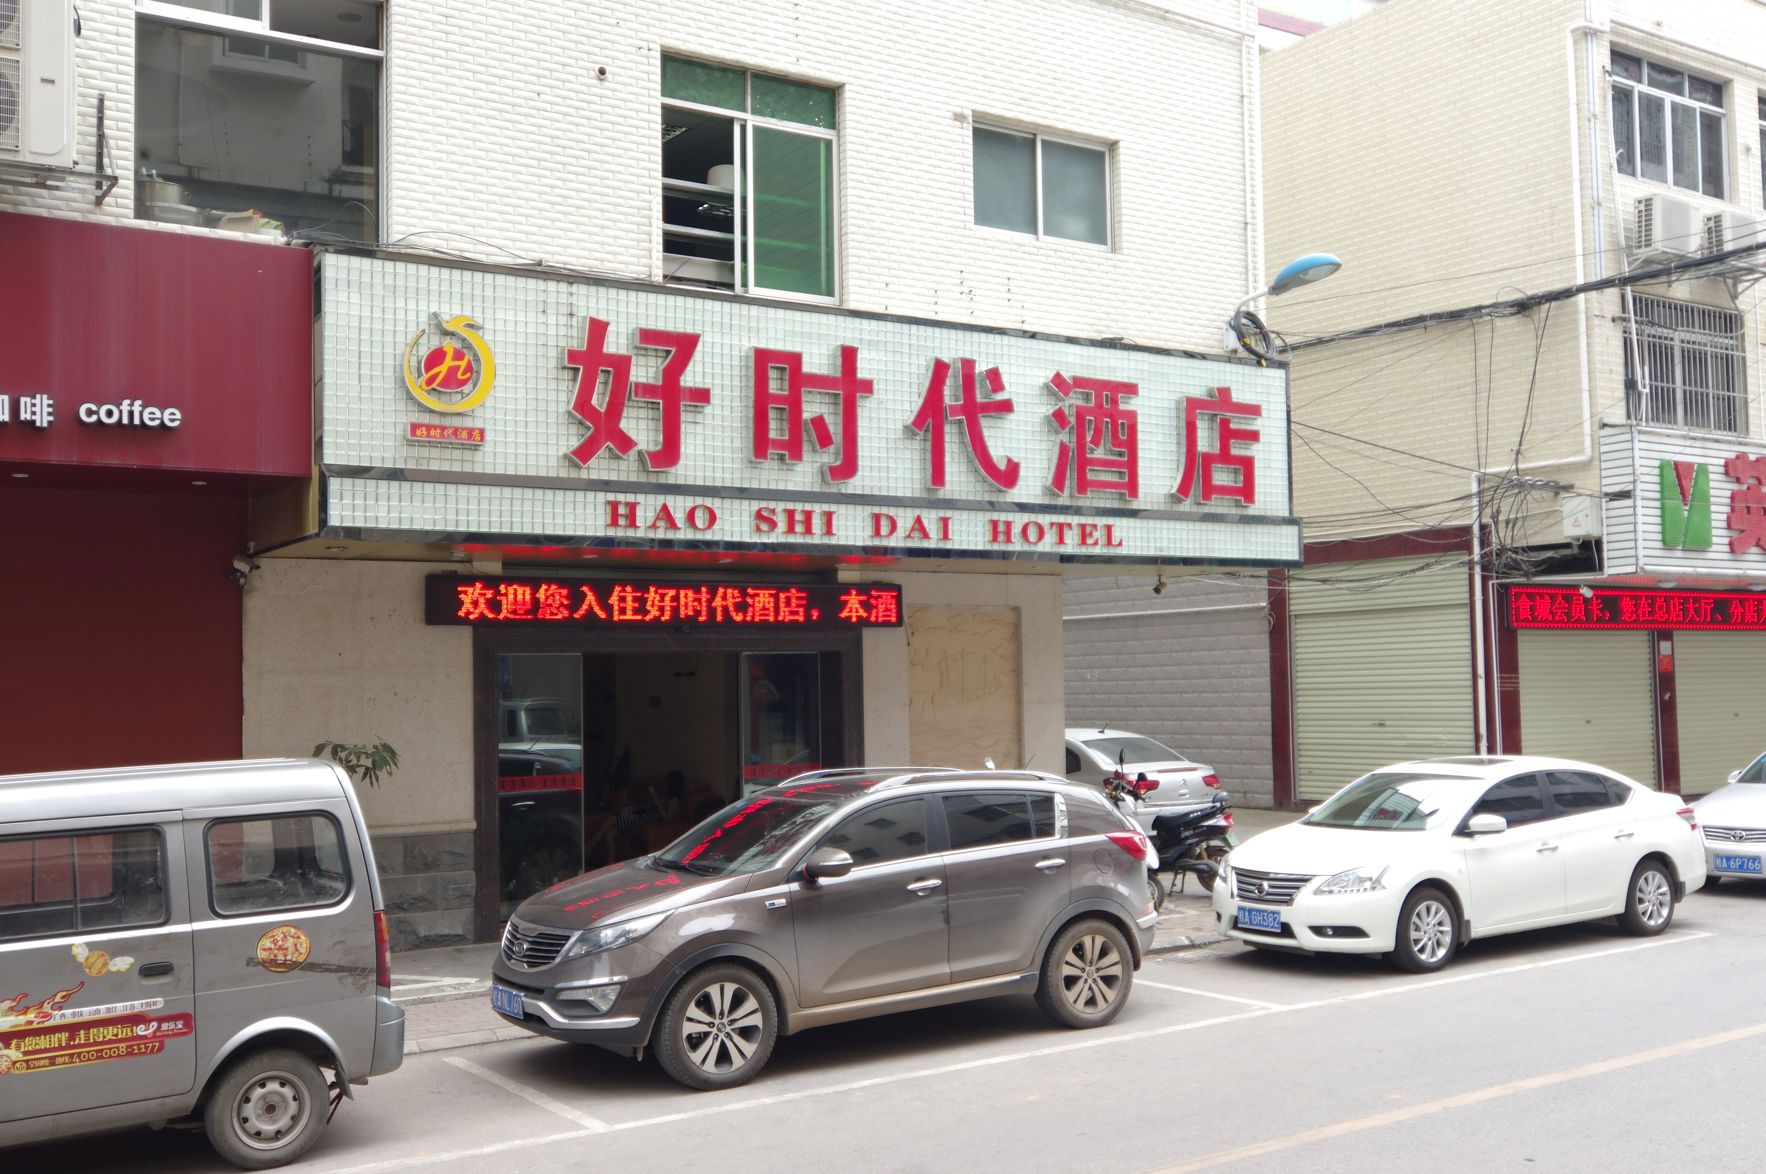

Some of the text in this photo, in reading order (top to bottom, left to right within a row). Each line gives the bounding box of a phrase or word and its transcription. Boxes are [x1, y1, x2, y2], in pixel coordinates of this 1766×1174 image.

[79, 399, 182, 427] coffee
[565, 316, 1263, 506] 好时代酒店
[414, 426, 482, 442] 好时代酒店
[605, 499, 1123, 547] HAO SHI DAI HOTEL
